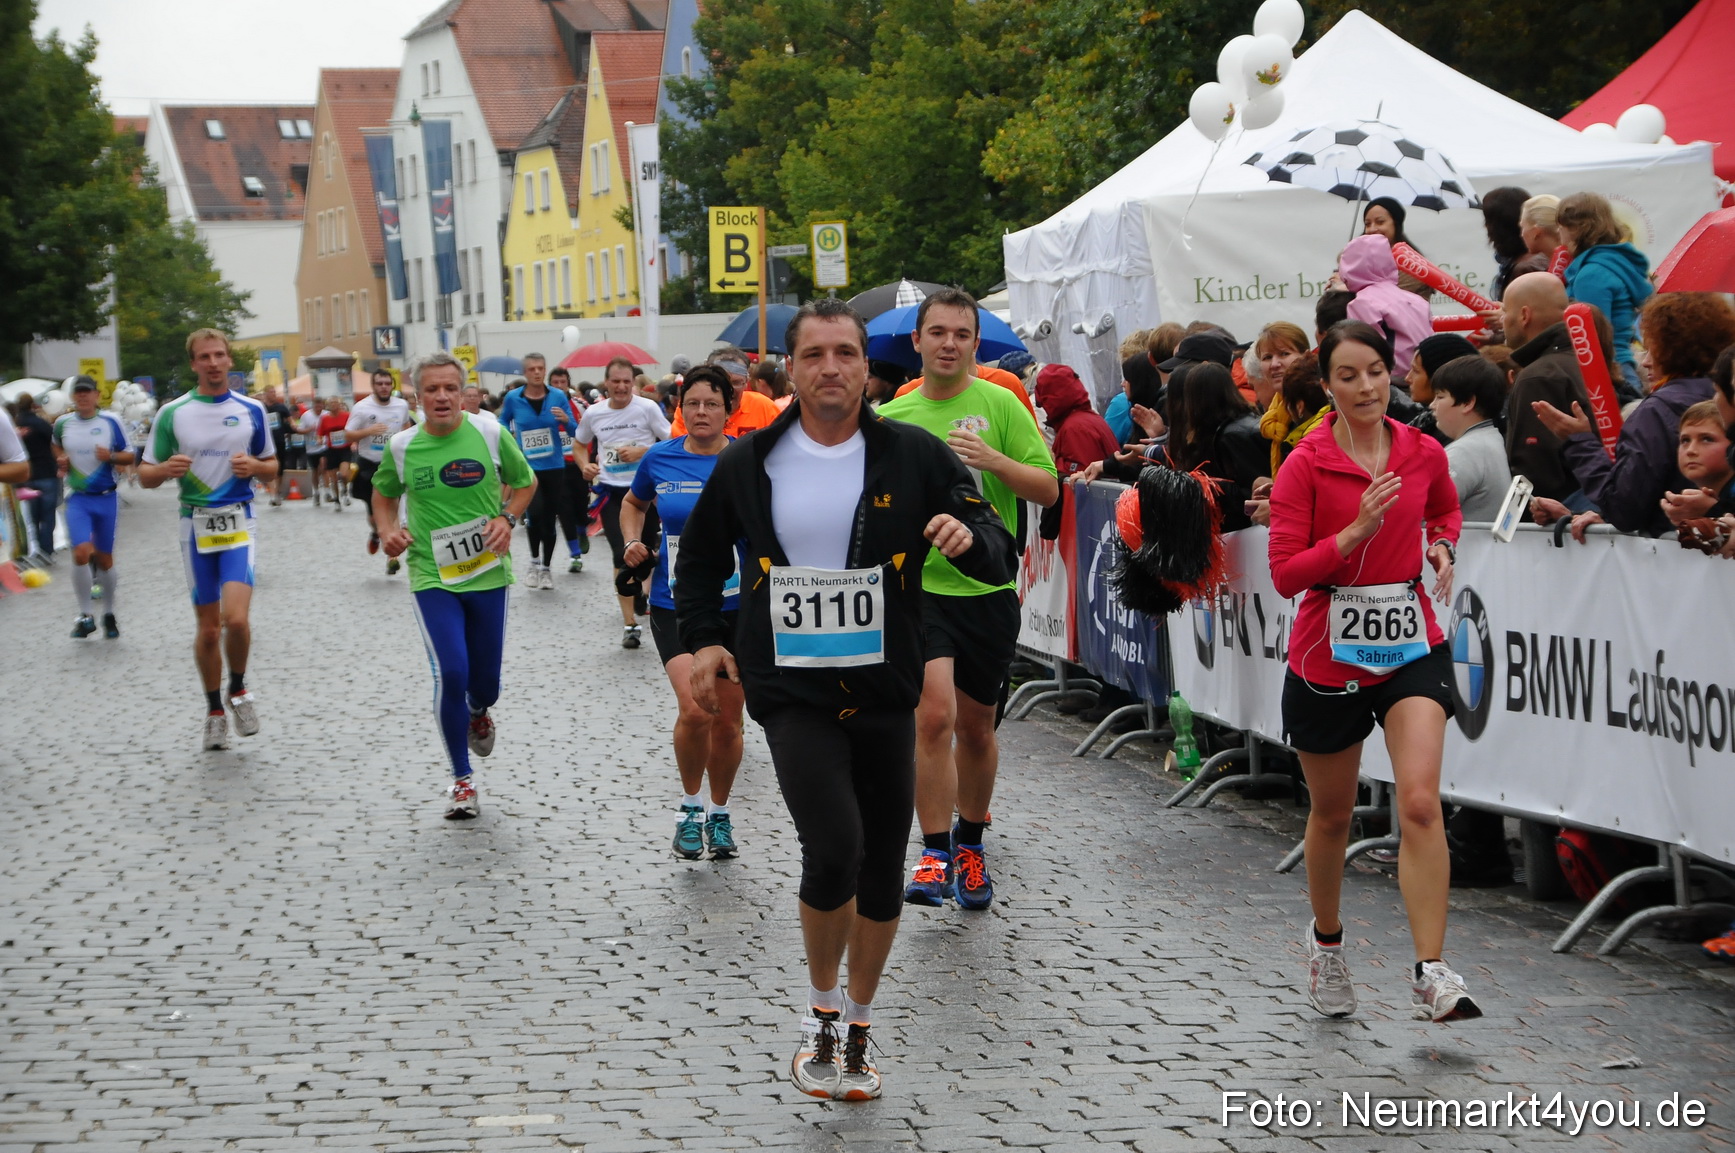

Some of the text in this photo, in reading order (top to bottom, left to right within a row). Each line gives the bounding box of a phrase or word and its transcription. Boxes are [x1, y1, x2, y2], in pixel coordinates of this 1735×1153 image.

[716, 210, 759, 226] Block
[535, 233, 554, 254] HOTEL
[724, 232, 752, 273] B
[1193, 274, 1290, 304] Kinder
[1297, 272, 1328, 299] br
[1436, 277, 1470, 301] BKK
[1586, 384, 1613, 430] BKK
[371, 434, 391, 445] 236
[524, 434, 550, 448] 2356
[199, 448, 230, 457] Willem
[606, 451, 620, 464] 24
[205, 514, 237, 532] 431
[451, 523, 480, 537] Neumarkt
[445, 532, 484, 561] 110
[668, 541, 679, 549] PA
[457, 559, 481, 574] Stefan
[773, 576, 864, 587] PARTL Neumarkt
[1333, 593, 1367, 604] PARTL
[782, 589, 874, 629] 3110
[1450, 591, 1489, 642] BMW
[1253, 592, 1291, 664] Lau
[1341, 605, 1419, 642] 2663
[1356, 649, 1405, 664] Sabrina
[1506, 630, 1597, 723] BMW
